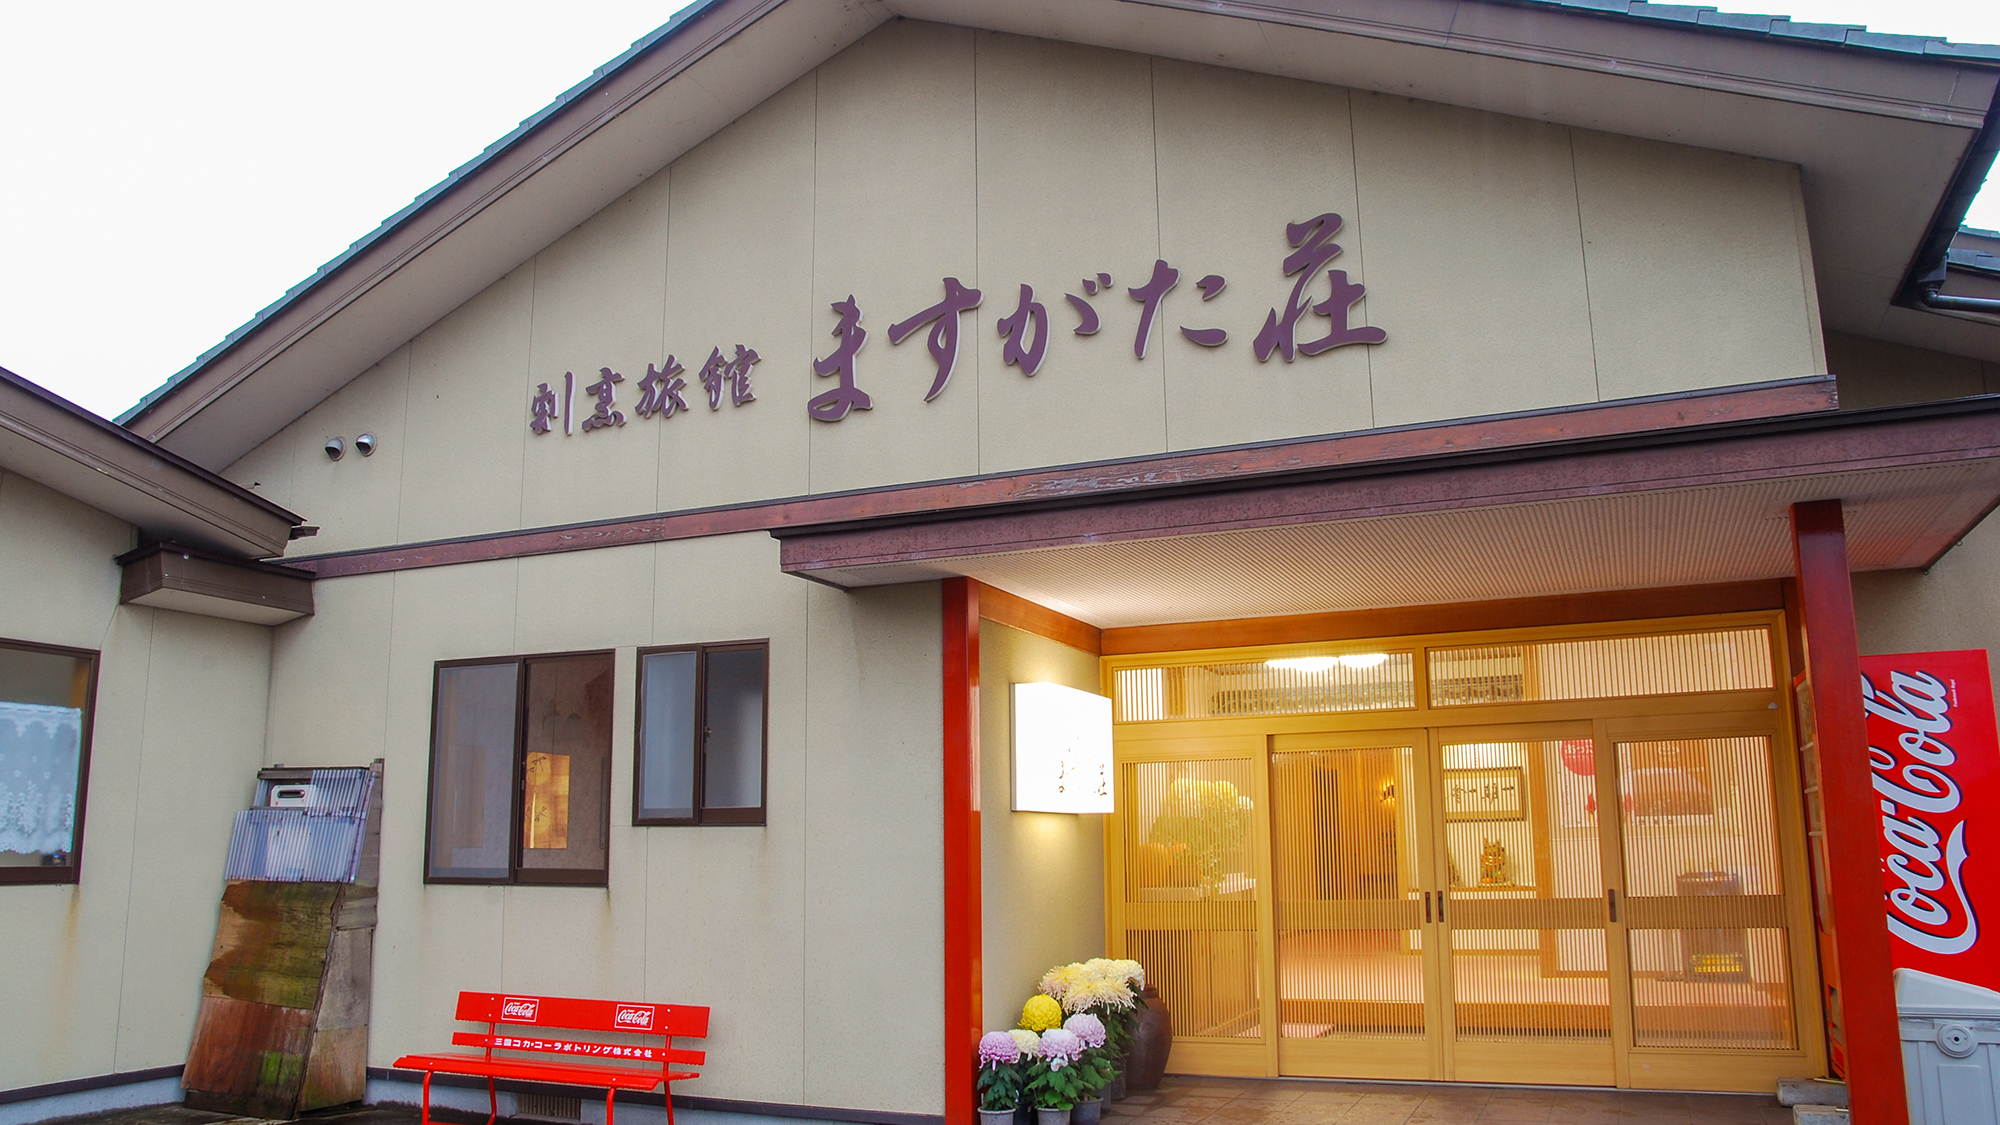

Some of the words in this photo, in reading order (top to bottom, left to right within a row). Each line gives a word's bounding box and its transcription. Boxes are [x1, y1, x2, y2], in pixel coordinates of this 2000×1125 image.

[808, 212, 1388, 422] ますがた荘
